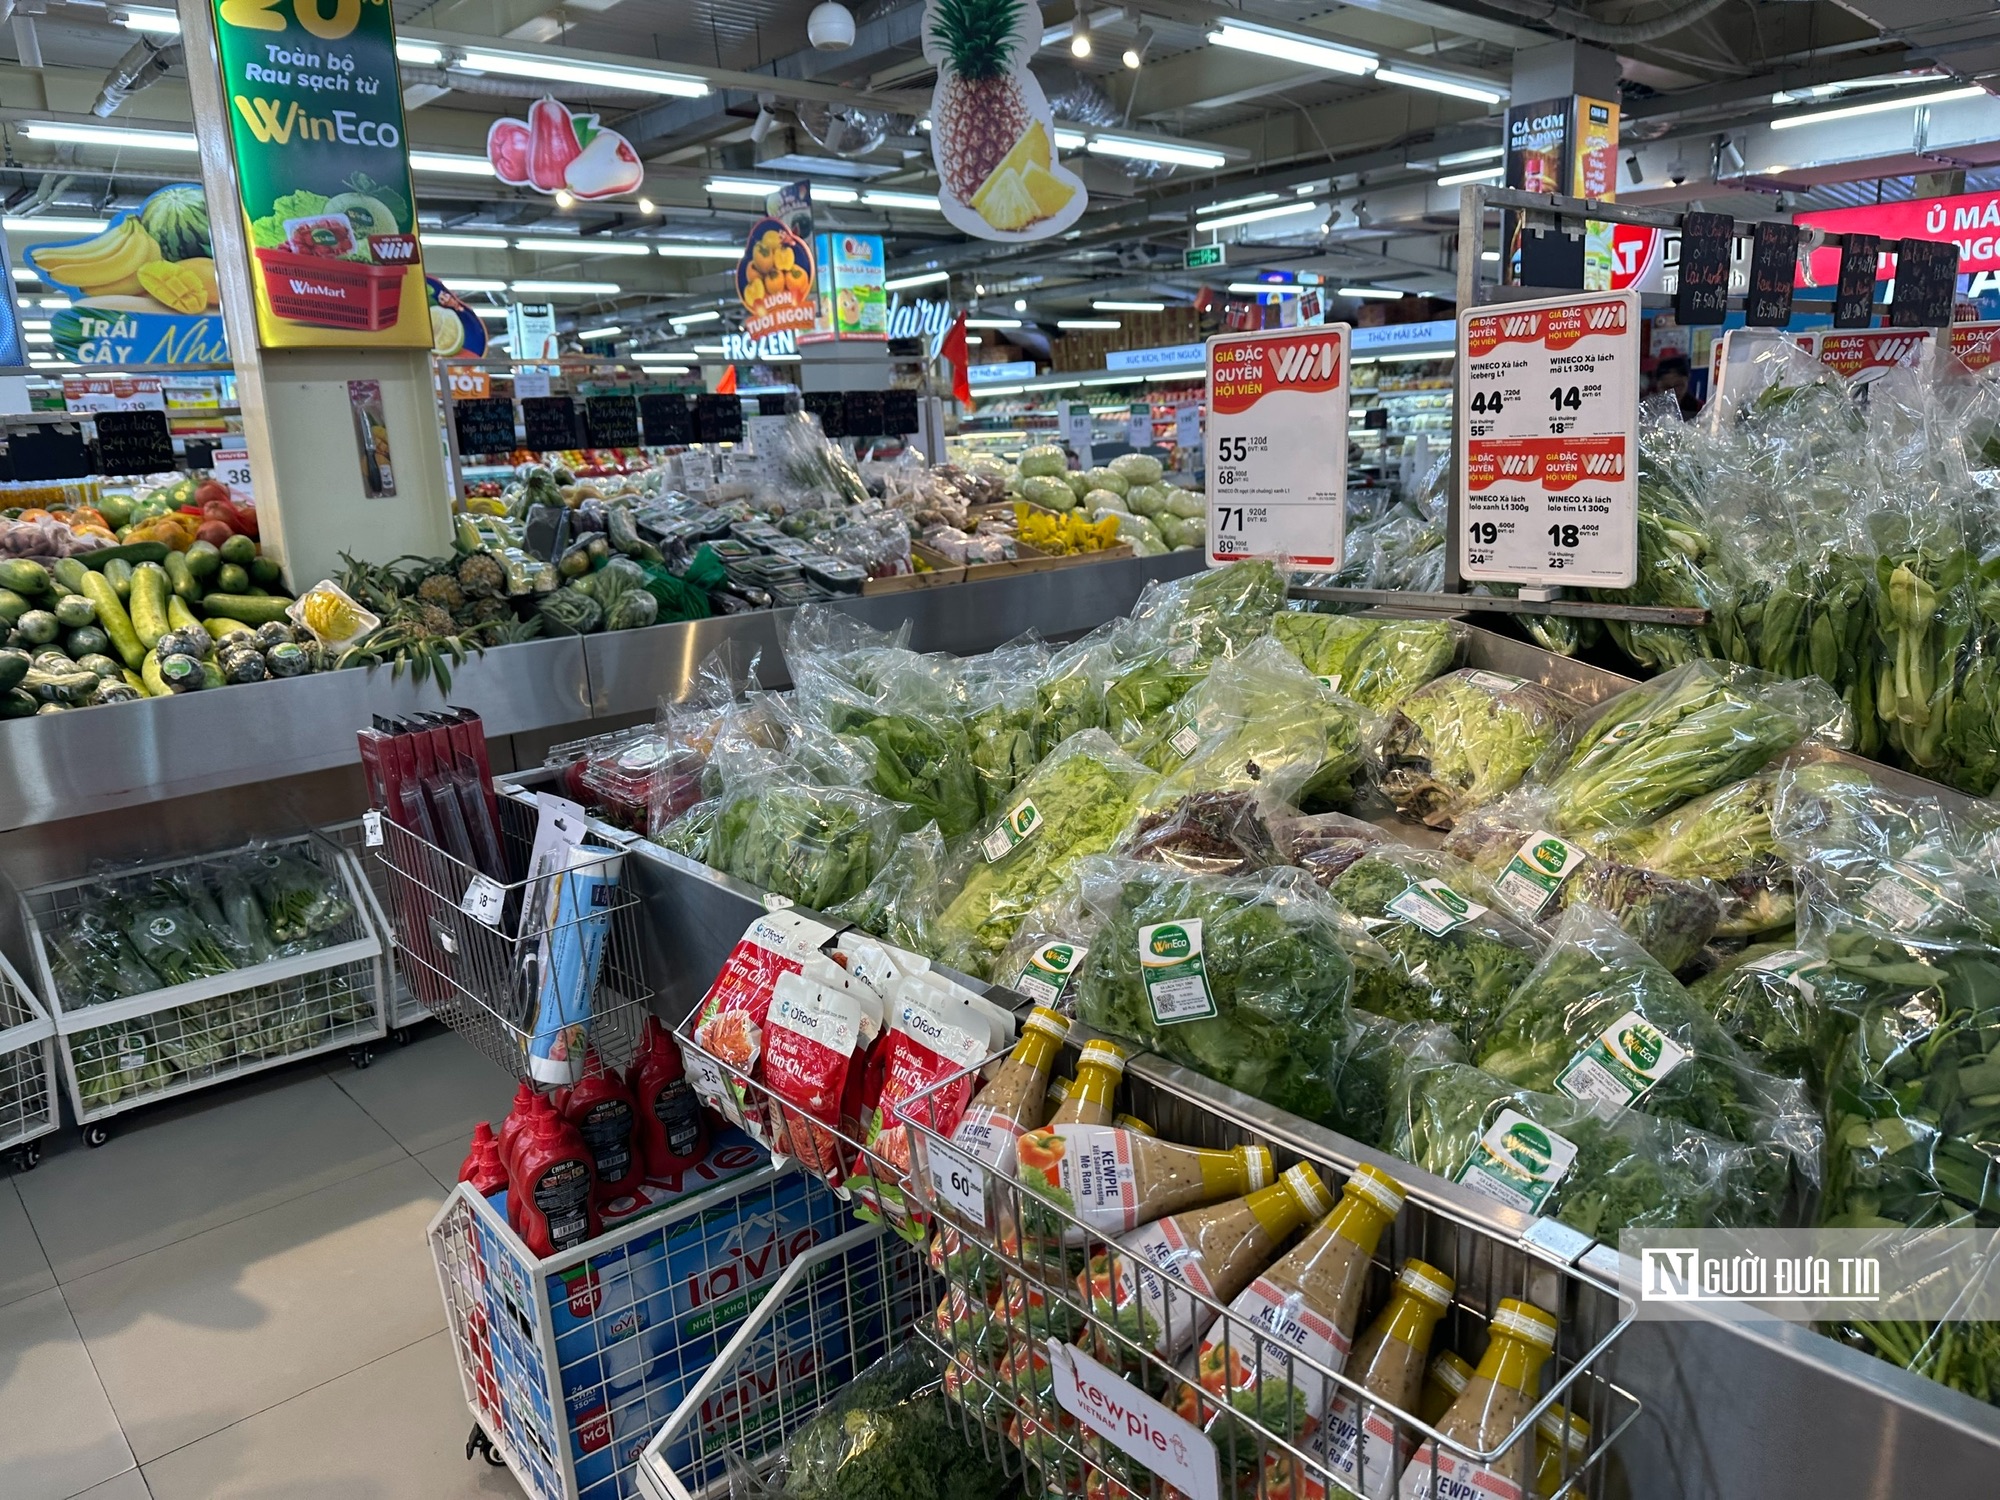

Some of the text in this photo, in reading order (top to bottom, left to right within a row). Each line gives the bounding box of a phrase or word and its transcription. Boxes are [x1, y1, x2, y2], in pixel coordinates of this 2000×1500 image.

[265, 44, 355, 76] Toàn bộ
[246, 63, 380, 95] Rau sạch từ
[234, 94, 399, 148] WinEco
[1512, 114, 1564, 135] CÁ CƠM
[1951, 236, 2000, 261] NG
[289, 279, 345, 298] WinMart
[1549, 307, 1581, 319] GIÁ ĐẶC
[78, 315, 137, 339] TRÁI
[1549, 319, 1581, 331] QUYỀN
[1549, 330, 1581, 340] HỘI VIÊN
[77, 338, 132, 364] CÂY
[1841, 338, 1864, 349] ĐẶC
[1216, 345, 1263, 363] GIÁ ĐẶC
[1550, 355, 1583, 365] WINECO
[1597, 353, 1614, 361] lách
[1822, 348, 1863, 360] QUYỀN
[1216, 363, 1262, 382] QUYỀN
[1471, 361, 1500, 371] WINECO
[1513, 360, 1528, 368] lách
[1564, 365, 1572, 373] L1
[1574, 364, 1594, 373] 300g
[1471, 370, 1505, 380] iceberg L1
[1216, 381, 1262, 398] HỘI VIÊN
[1471, 391, 1503, 415] 44
[1550, 386, 1581, 411] 14
[1471, 425, 1484, 436] 55
[1550, 423, 1564, 434] 18
[1219, 436, 1267, 462] 55 .120đ
[1546, 452, 1578, 462] GIÁ ĐẶC
[1478, 453, 1494, 462] ĐẶC
[1546, 461, 1577, 472] QUYỀN
[227, 469, 251, 485] 38
[1219, 471, 1233, 484] 68
[1546, 472, 1577, 482] HỘI VIÊN
[1469, 503, 1481, 511] lolo
[1510, 504, 1529, 512] 300g
[1548, 495, 1580, 503] WINECO
[1595, 495, 1611, 504] lách
[1548, 504, 1561, 512] lolo
[1563, 504, 1576, 512] tím
[1588, 505, 1609, 514] 300g
[1218, 507, 1267, 532] 71 .920đ
[1469, 522, 1497, 545] 19
[1548, 524, 1579, 548] 18
[1219, 540, 1234, 553] 89
[1470, 554, 1485, 565] 24
[1549, 557, 1564, 568] 23
[1153, 938, 1187, 953] WinEco
[551, 1161, 574, 1174] CHIN-SU
[1080, 1155, 1092, 1196] Mè Rang
[1101, 1150, 1118, 1197] KEWPIE
[951, 1171, 969, 1197] 60
[1093, 1156, 1104, 1206] Salad Dressing
[1144, 1273, 1162, 1300] Rang
[1264, 1342, 1290, 1366] Rang
[1073, 1367, 1167, 1452] kewpie
[1077, 1399, 1116, 1431] VIETNAM
